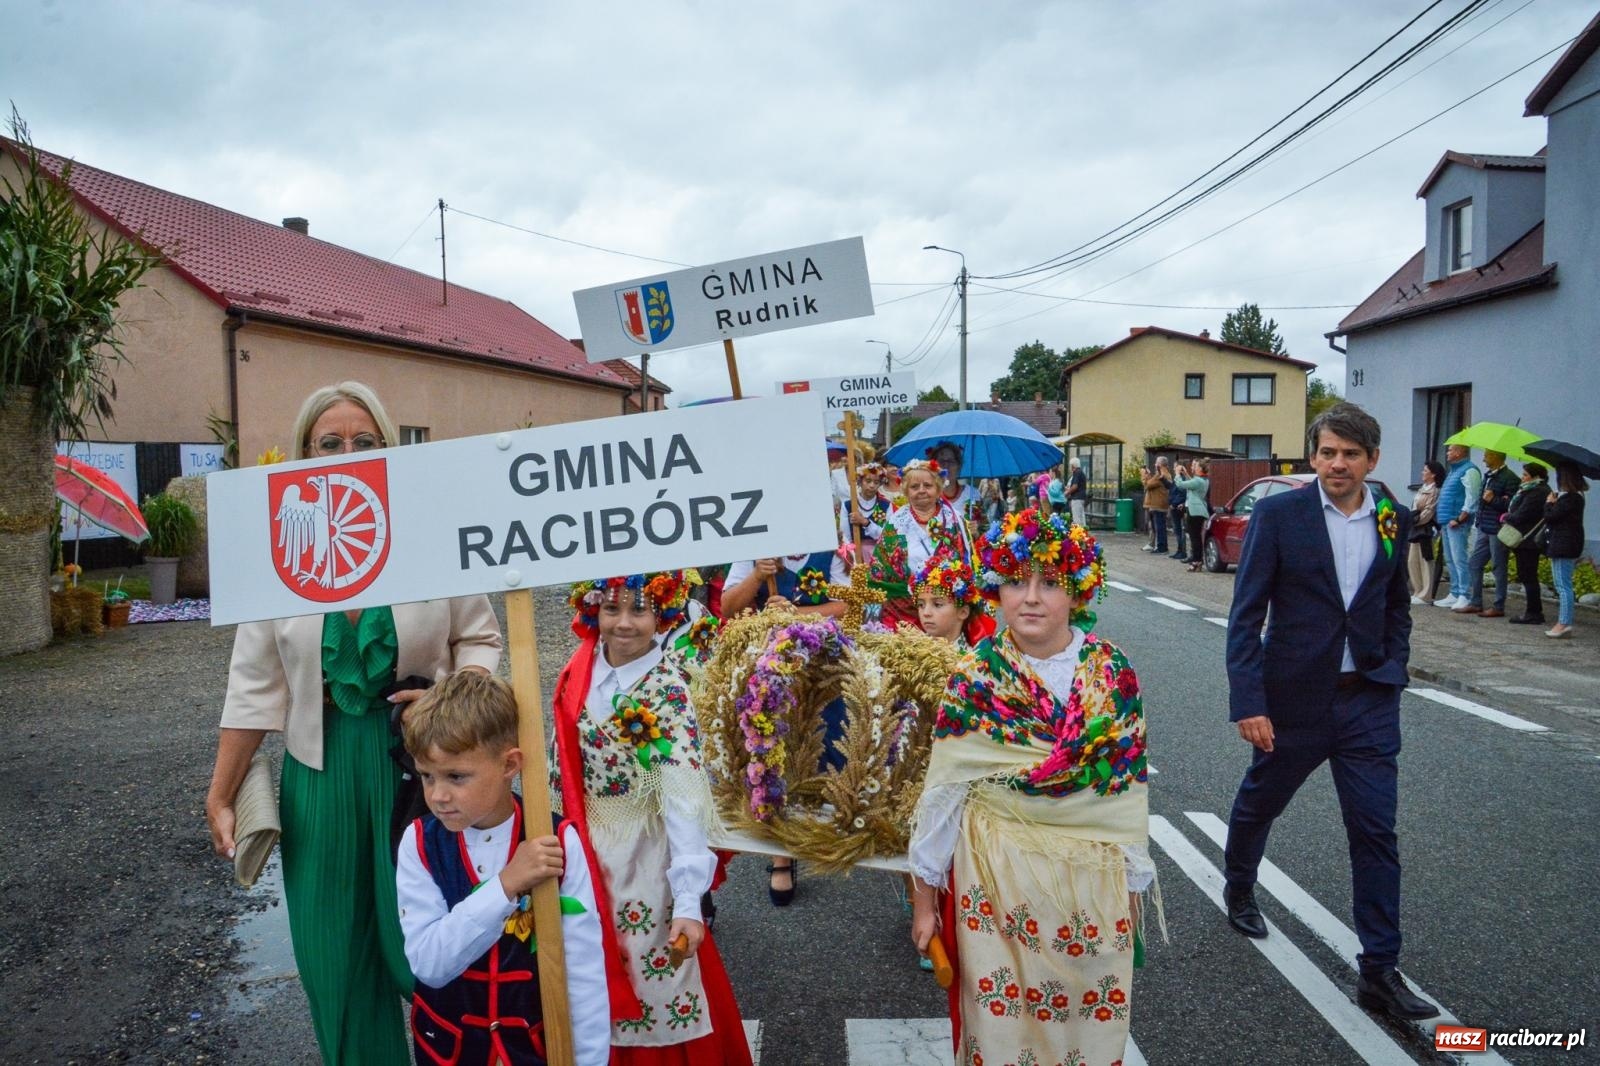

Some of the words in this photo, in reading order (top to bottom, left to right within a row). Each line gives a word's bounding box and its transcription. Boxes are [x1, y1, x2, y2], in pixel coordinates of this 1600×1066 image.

[701, 257, 823, 300] GMINA
[715, 295, 819, 330] Rudnik
[240, 349, 250, 362] 36
[840, 376, 892, 392] GMINA
[826, 391, 908, 409] Krzanowice
[190, 453, 203, 467] TU
[508, 433, 704, 497] GMINA
[458, 489, 768, 570] RACIBÓRZ
